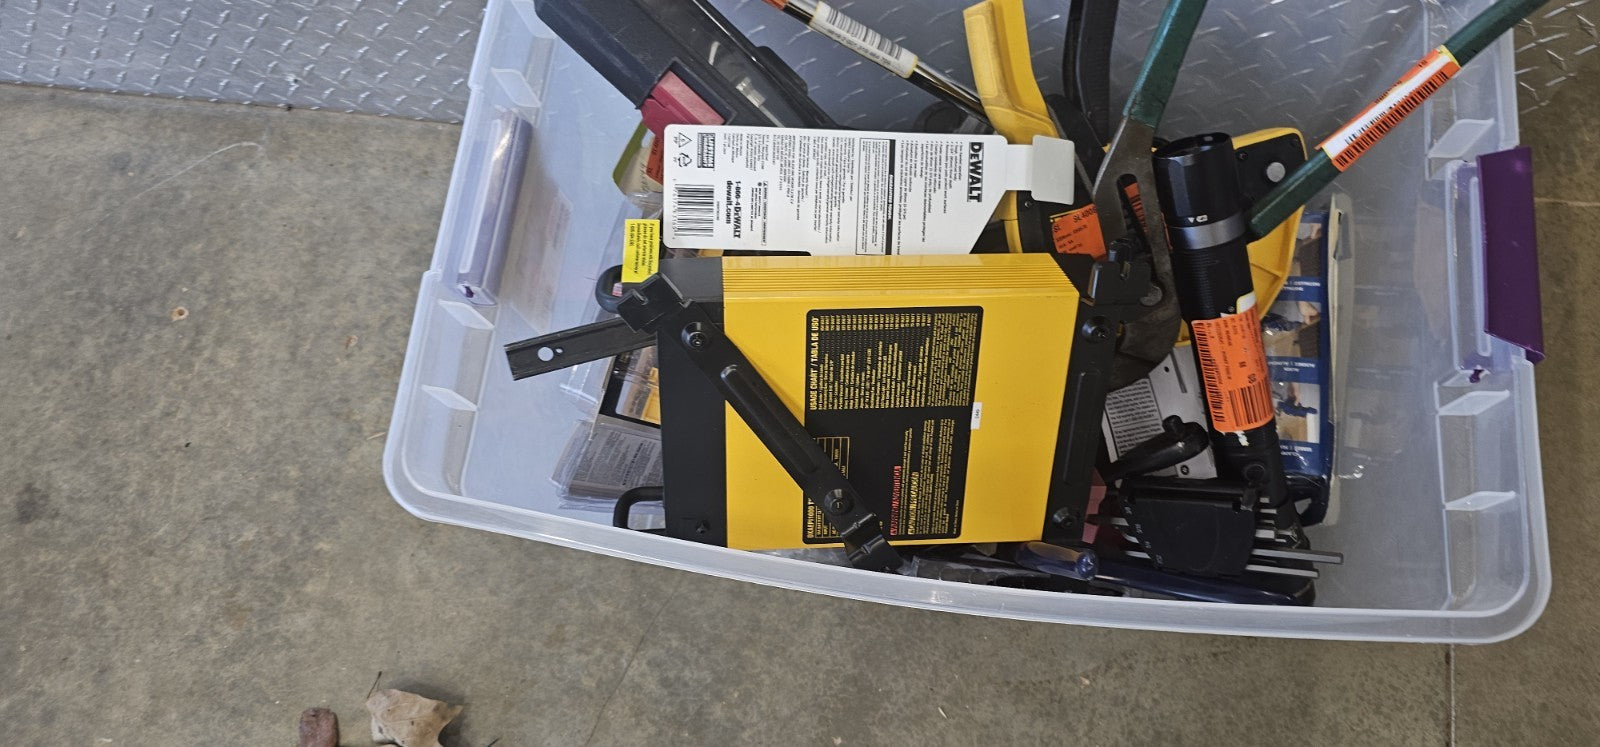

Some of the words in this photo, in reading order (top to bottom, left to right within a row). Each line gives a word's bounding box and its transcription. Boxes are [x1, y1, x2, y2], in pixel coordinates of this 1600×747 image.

[726, 180, 734, 224] dewalt.com
[811, 333, 819, 341] DE
[811, 341, 819, 362] TABLA
[810, 390, 818, 410] USAGE
